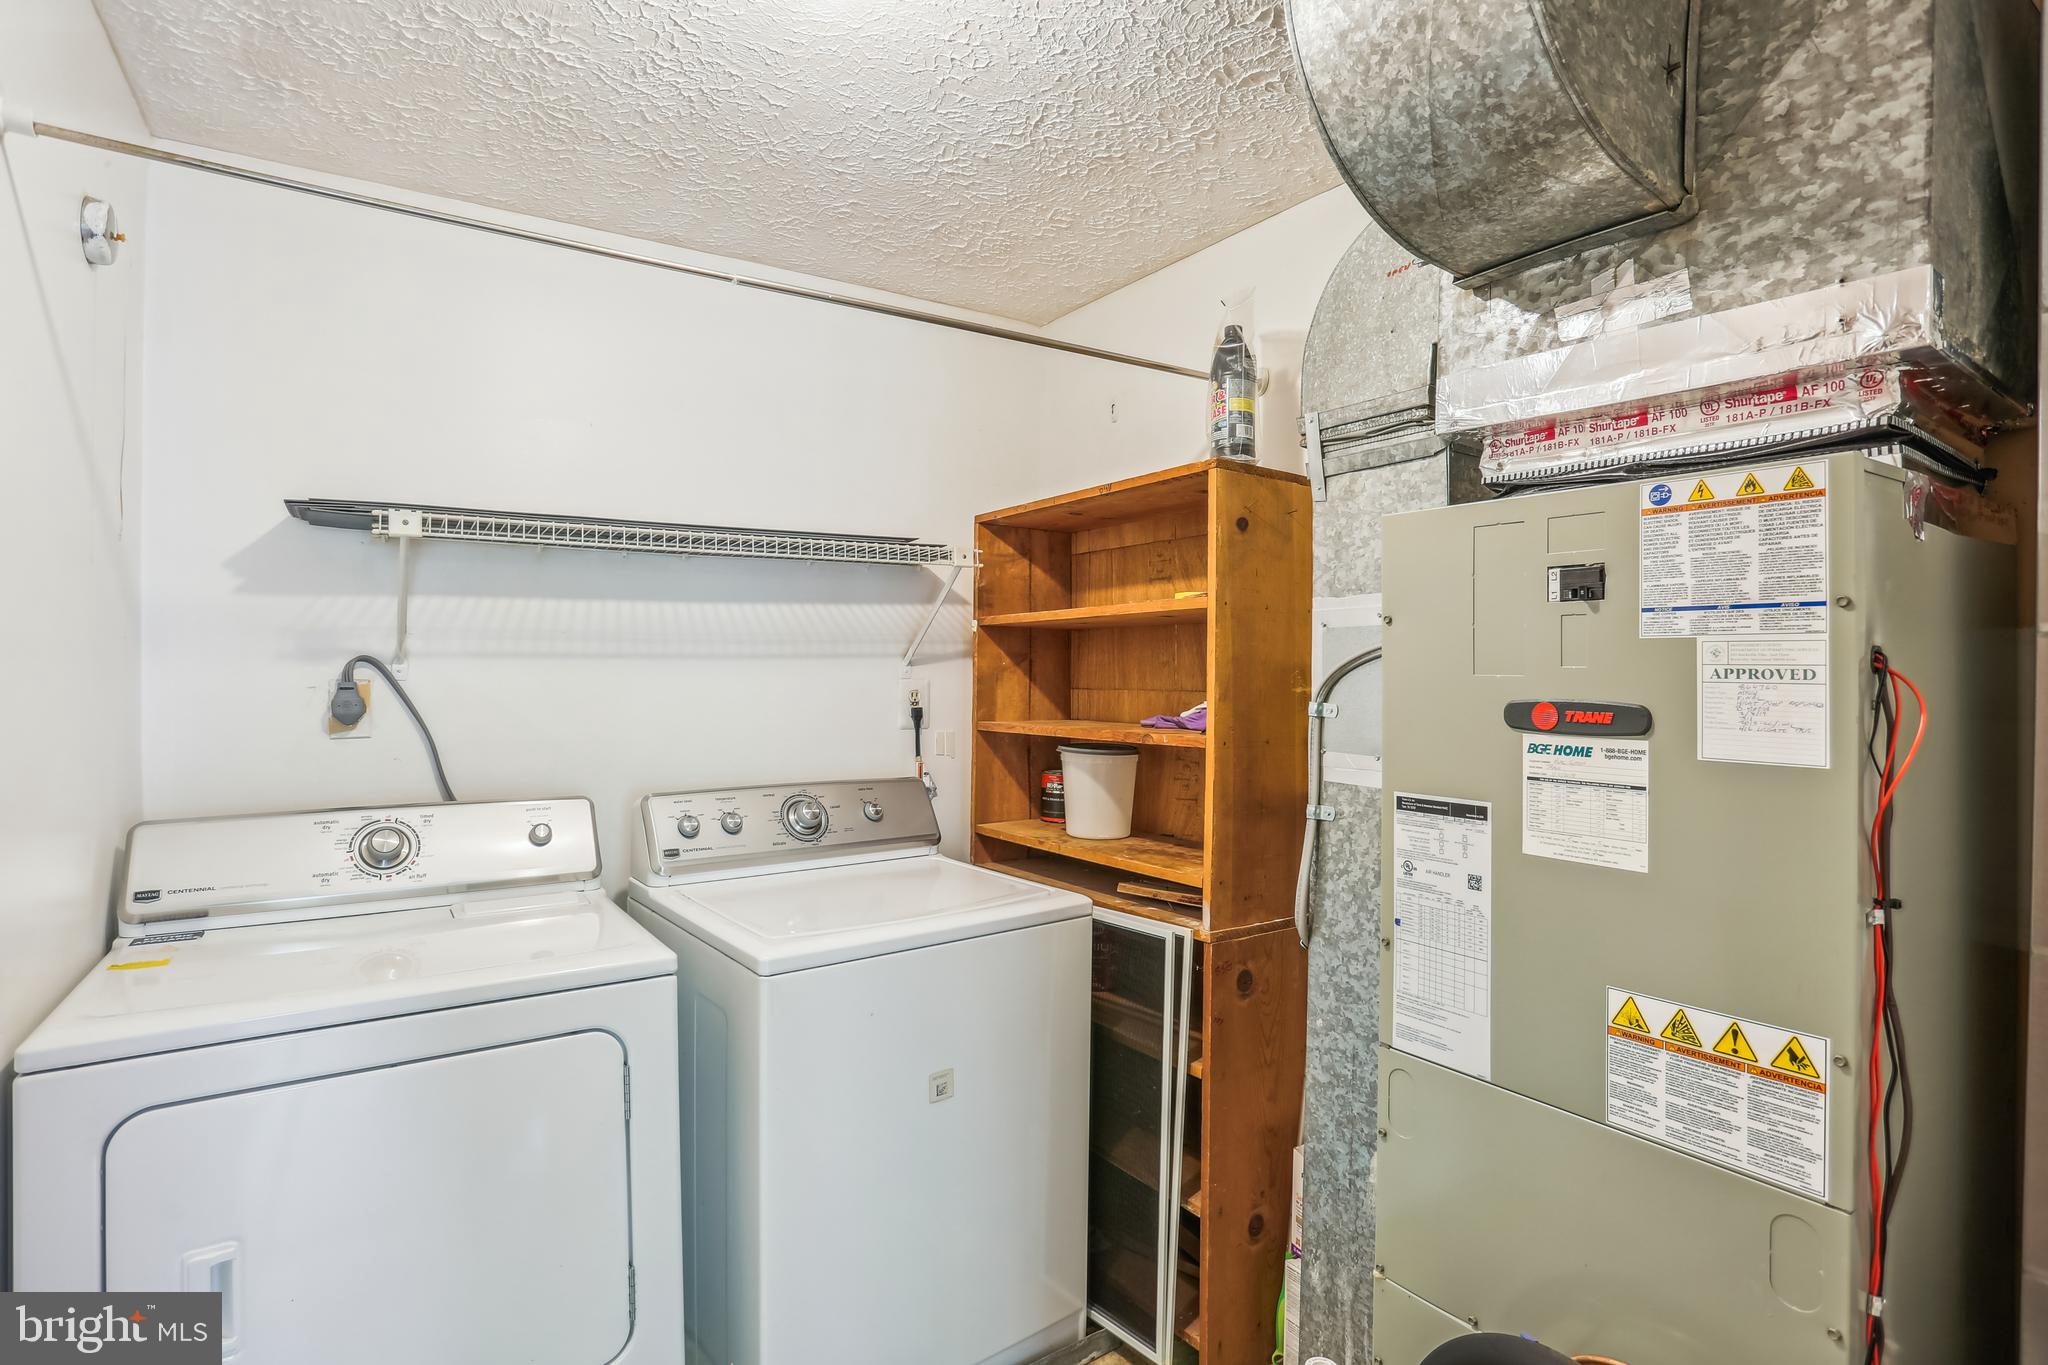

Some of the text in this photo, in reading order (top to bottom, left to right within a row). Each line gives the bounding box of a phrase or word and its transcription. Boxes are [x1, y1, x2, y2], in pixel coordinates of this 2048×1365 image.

[1725, 380, 1845, 409] Shurtape AF 100
[1858, 387, 1883, 397] LISTED
[1726, 410, 1766, 423] 181A-P
[1780, 398, 1831, 414] 181B-FX
[1589, 407, 1688, 434] Shurtape AF 100
[1700, 415, 1720, 424] LISTED
[1504, 431, 1548, 448] Shurtape
[1558, 426, 1571, 437] AF
[1590, 433, 1624, 447] 181A-P
[1635, 424, 1677, 439] 181B-FX
[1543, 438, 1580, 452] 181B-FX
[1698, 497, 1756, 509] AVERTISSEMENT
[1768, 490, 1824, 502] ADVERTENCIA
[1652, 505, 1684, 515] WARNING
[1710, 667, 1817, 680] APPROVED
[1565, 710, 1614, 725] TRANE
[1527, 742, 1593, 758] BGE HOME
[1600, 747, 1647, 756] 1-888-BGE-HOME
[1604, 753, 1643, 762] bgehome.com
[167, 886, 217, 895] CENTENNIAL
[1621, 1031, 1655, 1046] WARNING
[1674, 1045, 1741, 1070] AVERTISSEMENT
[1759, 1068, 1823, 1092] ADVERTENCIA
